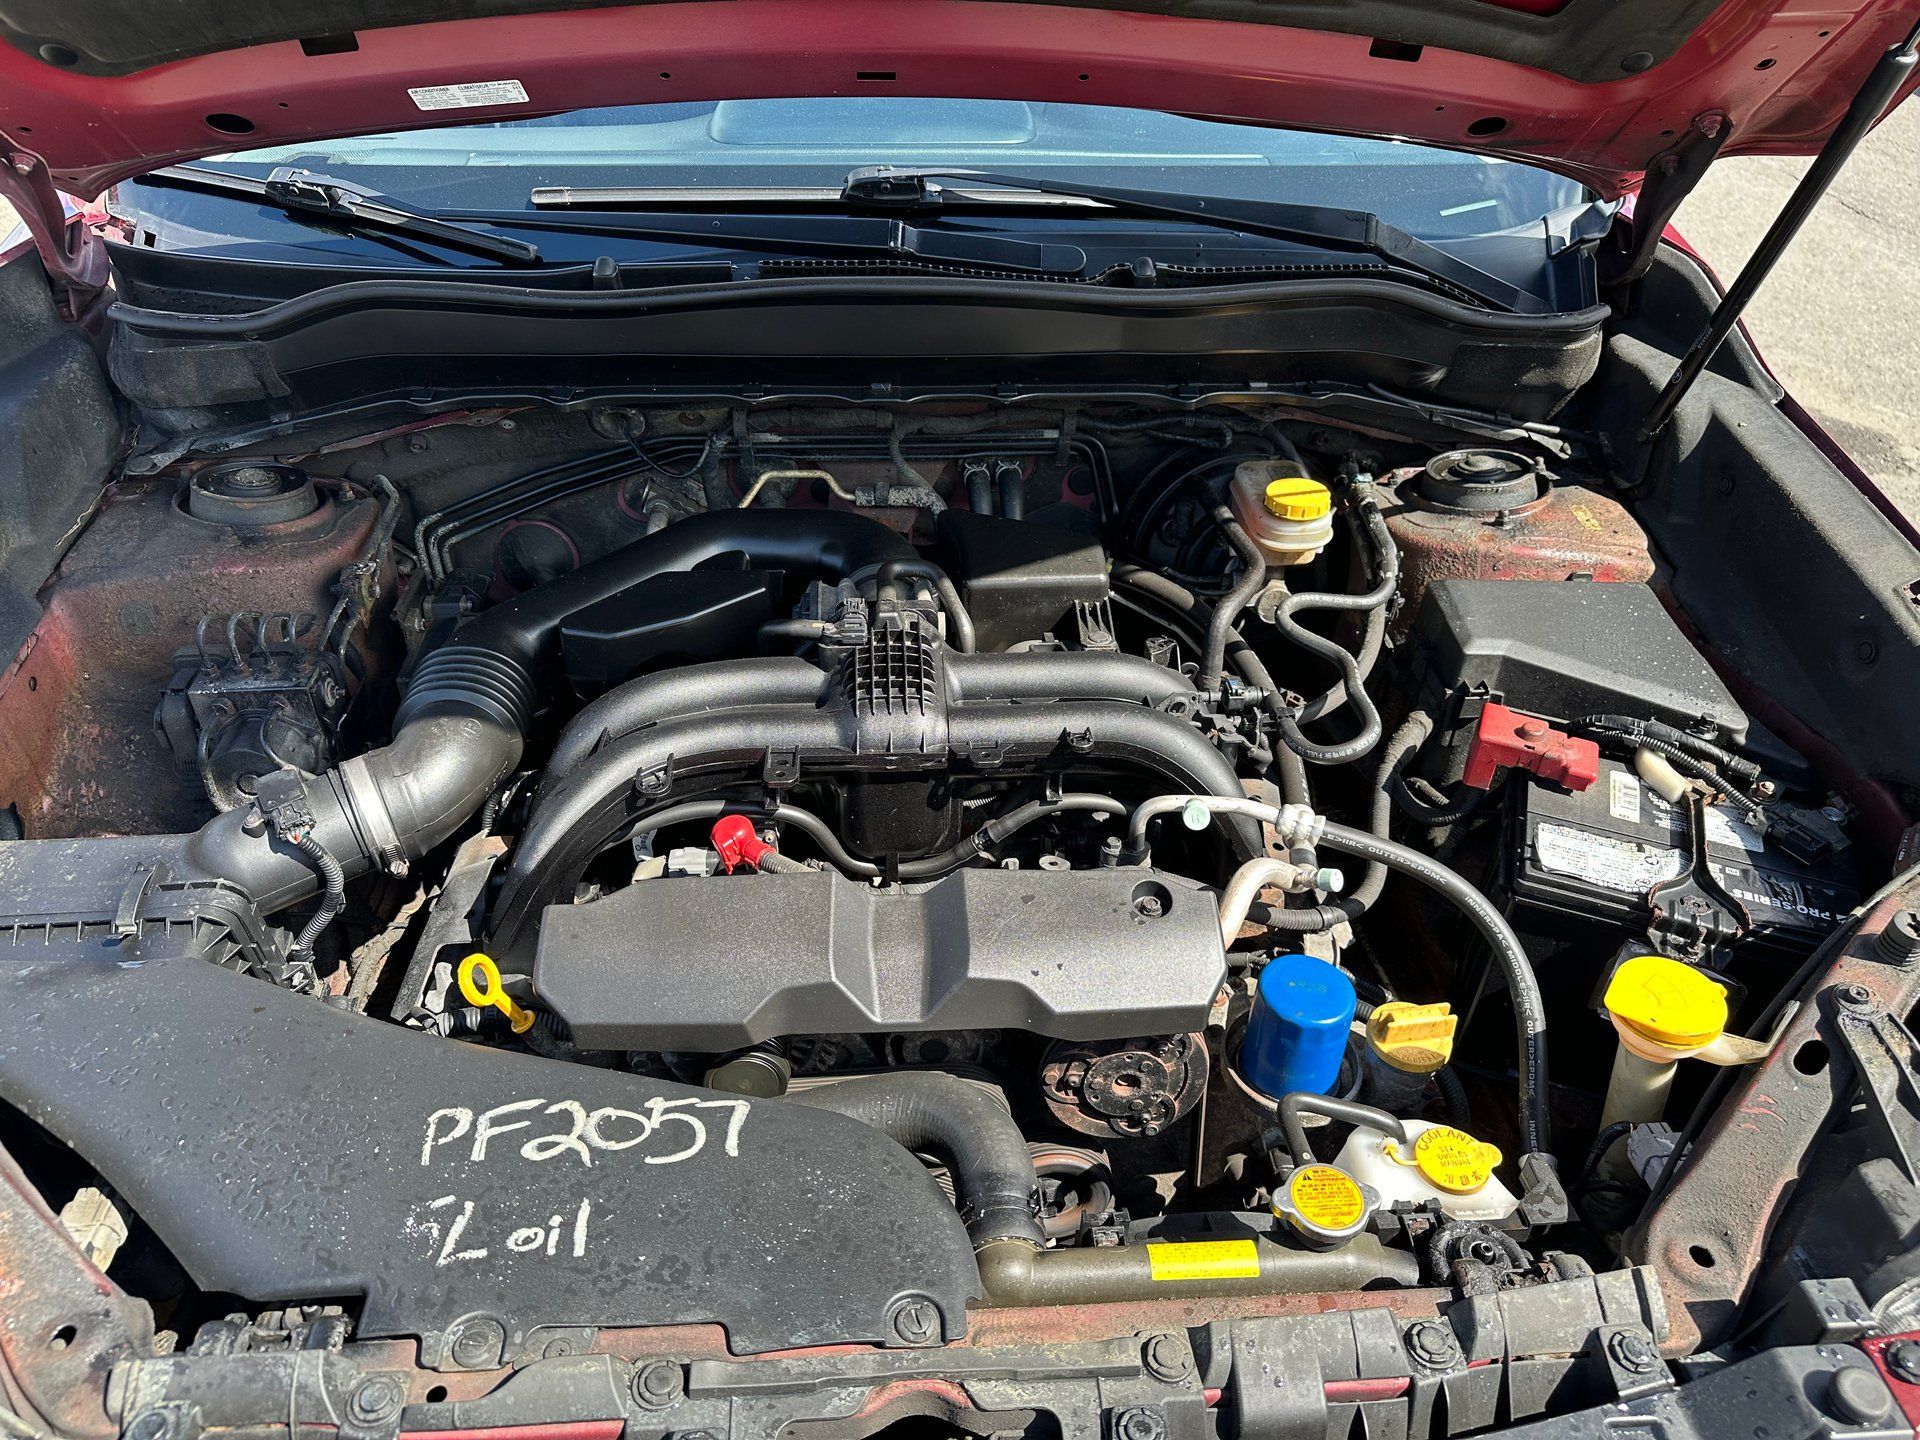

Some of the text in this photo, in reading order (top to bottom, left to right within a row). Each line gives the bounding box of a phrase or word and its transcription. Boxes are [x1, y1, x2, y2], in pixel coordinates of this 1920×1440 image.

[421, 1097, 751, 1168] PF2057
[1417, 1129, 1476, 1152] COOLANT
[1439, 1158, 1471, 1168] MANUAL
[505, 1197, 591, 1258] oil
